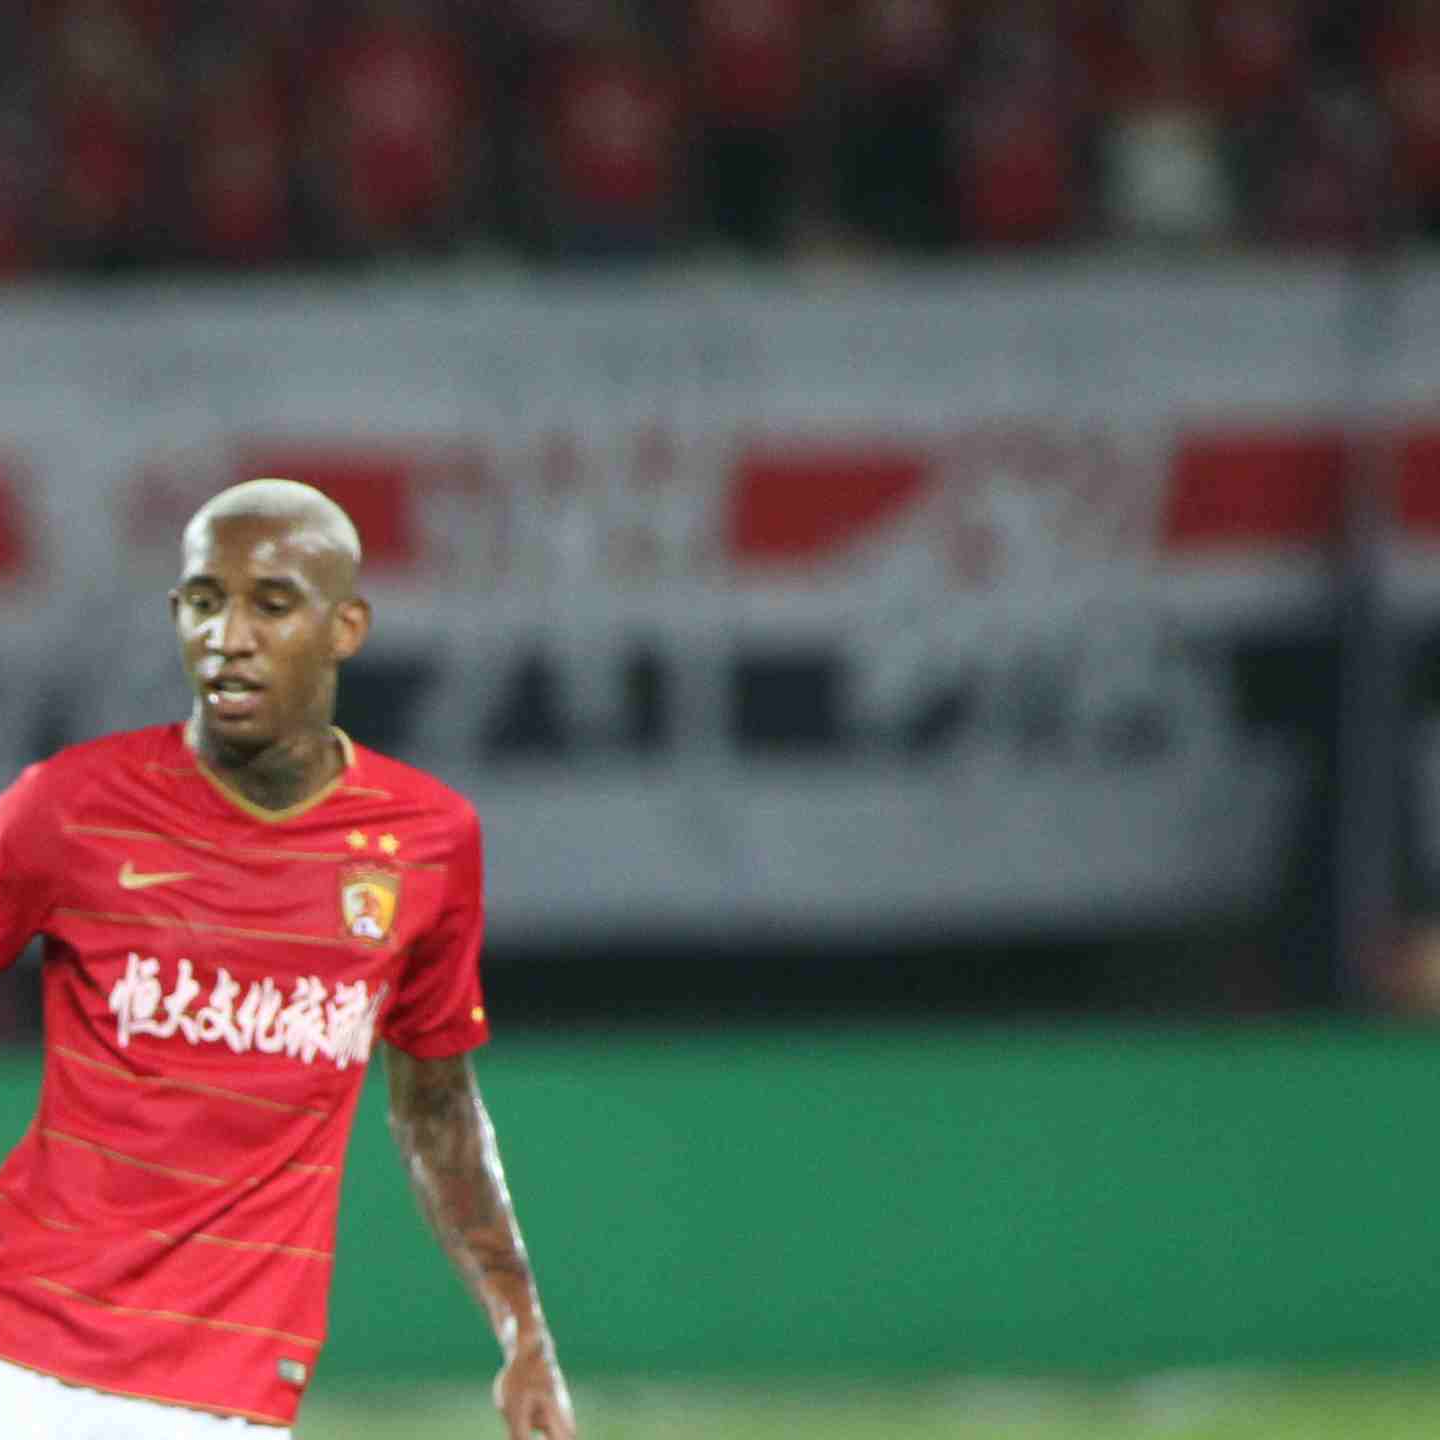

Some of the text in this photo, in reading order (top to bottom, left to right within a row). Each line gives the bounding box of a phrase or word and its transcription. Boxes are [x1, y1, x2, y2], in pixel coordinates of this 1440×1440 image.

[109, 951, 389, 1071] 恒大文化旅游
